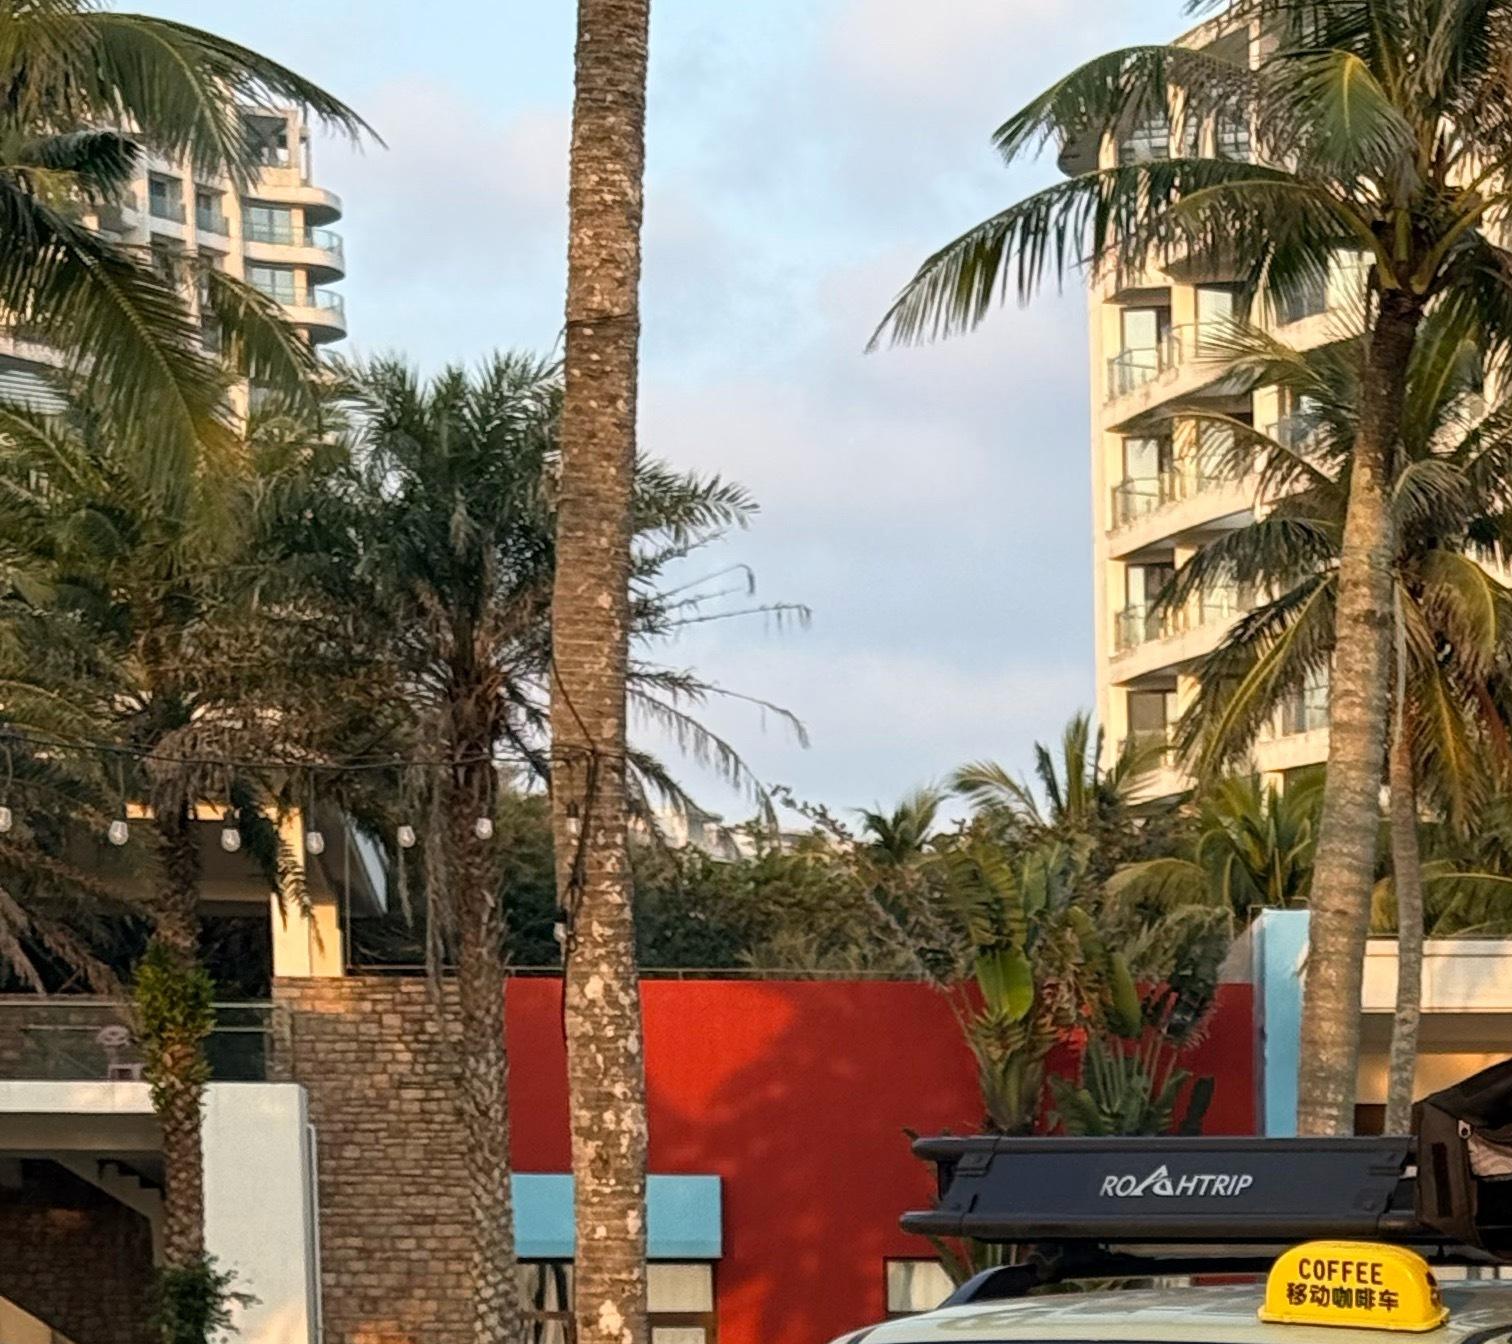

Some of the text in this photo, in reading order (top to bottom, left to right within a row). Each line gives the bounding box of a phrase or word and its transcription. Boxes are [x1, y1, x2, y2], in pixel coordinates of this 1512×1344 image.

[1298, 1257, 1383, 1284] COFFEE
[1286, 1282, 1399, 1312] 移动咖啡车
